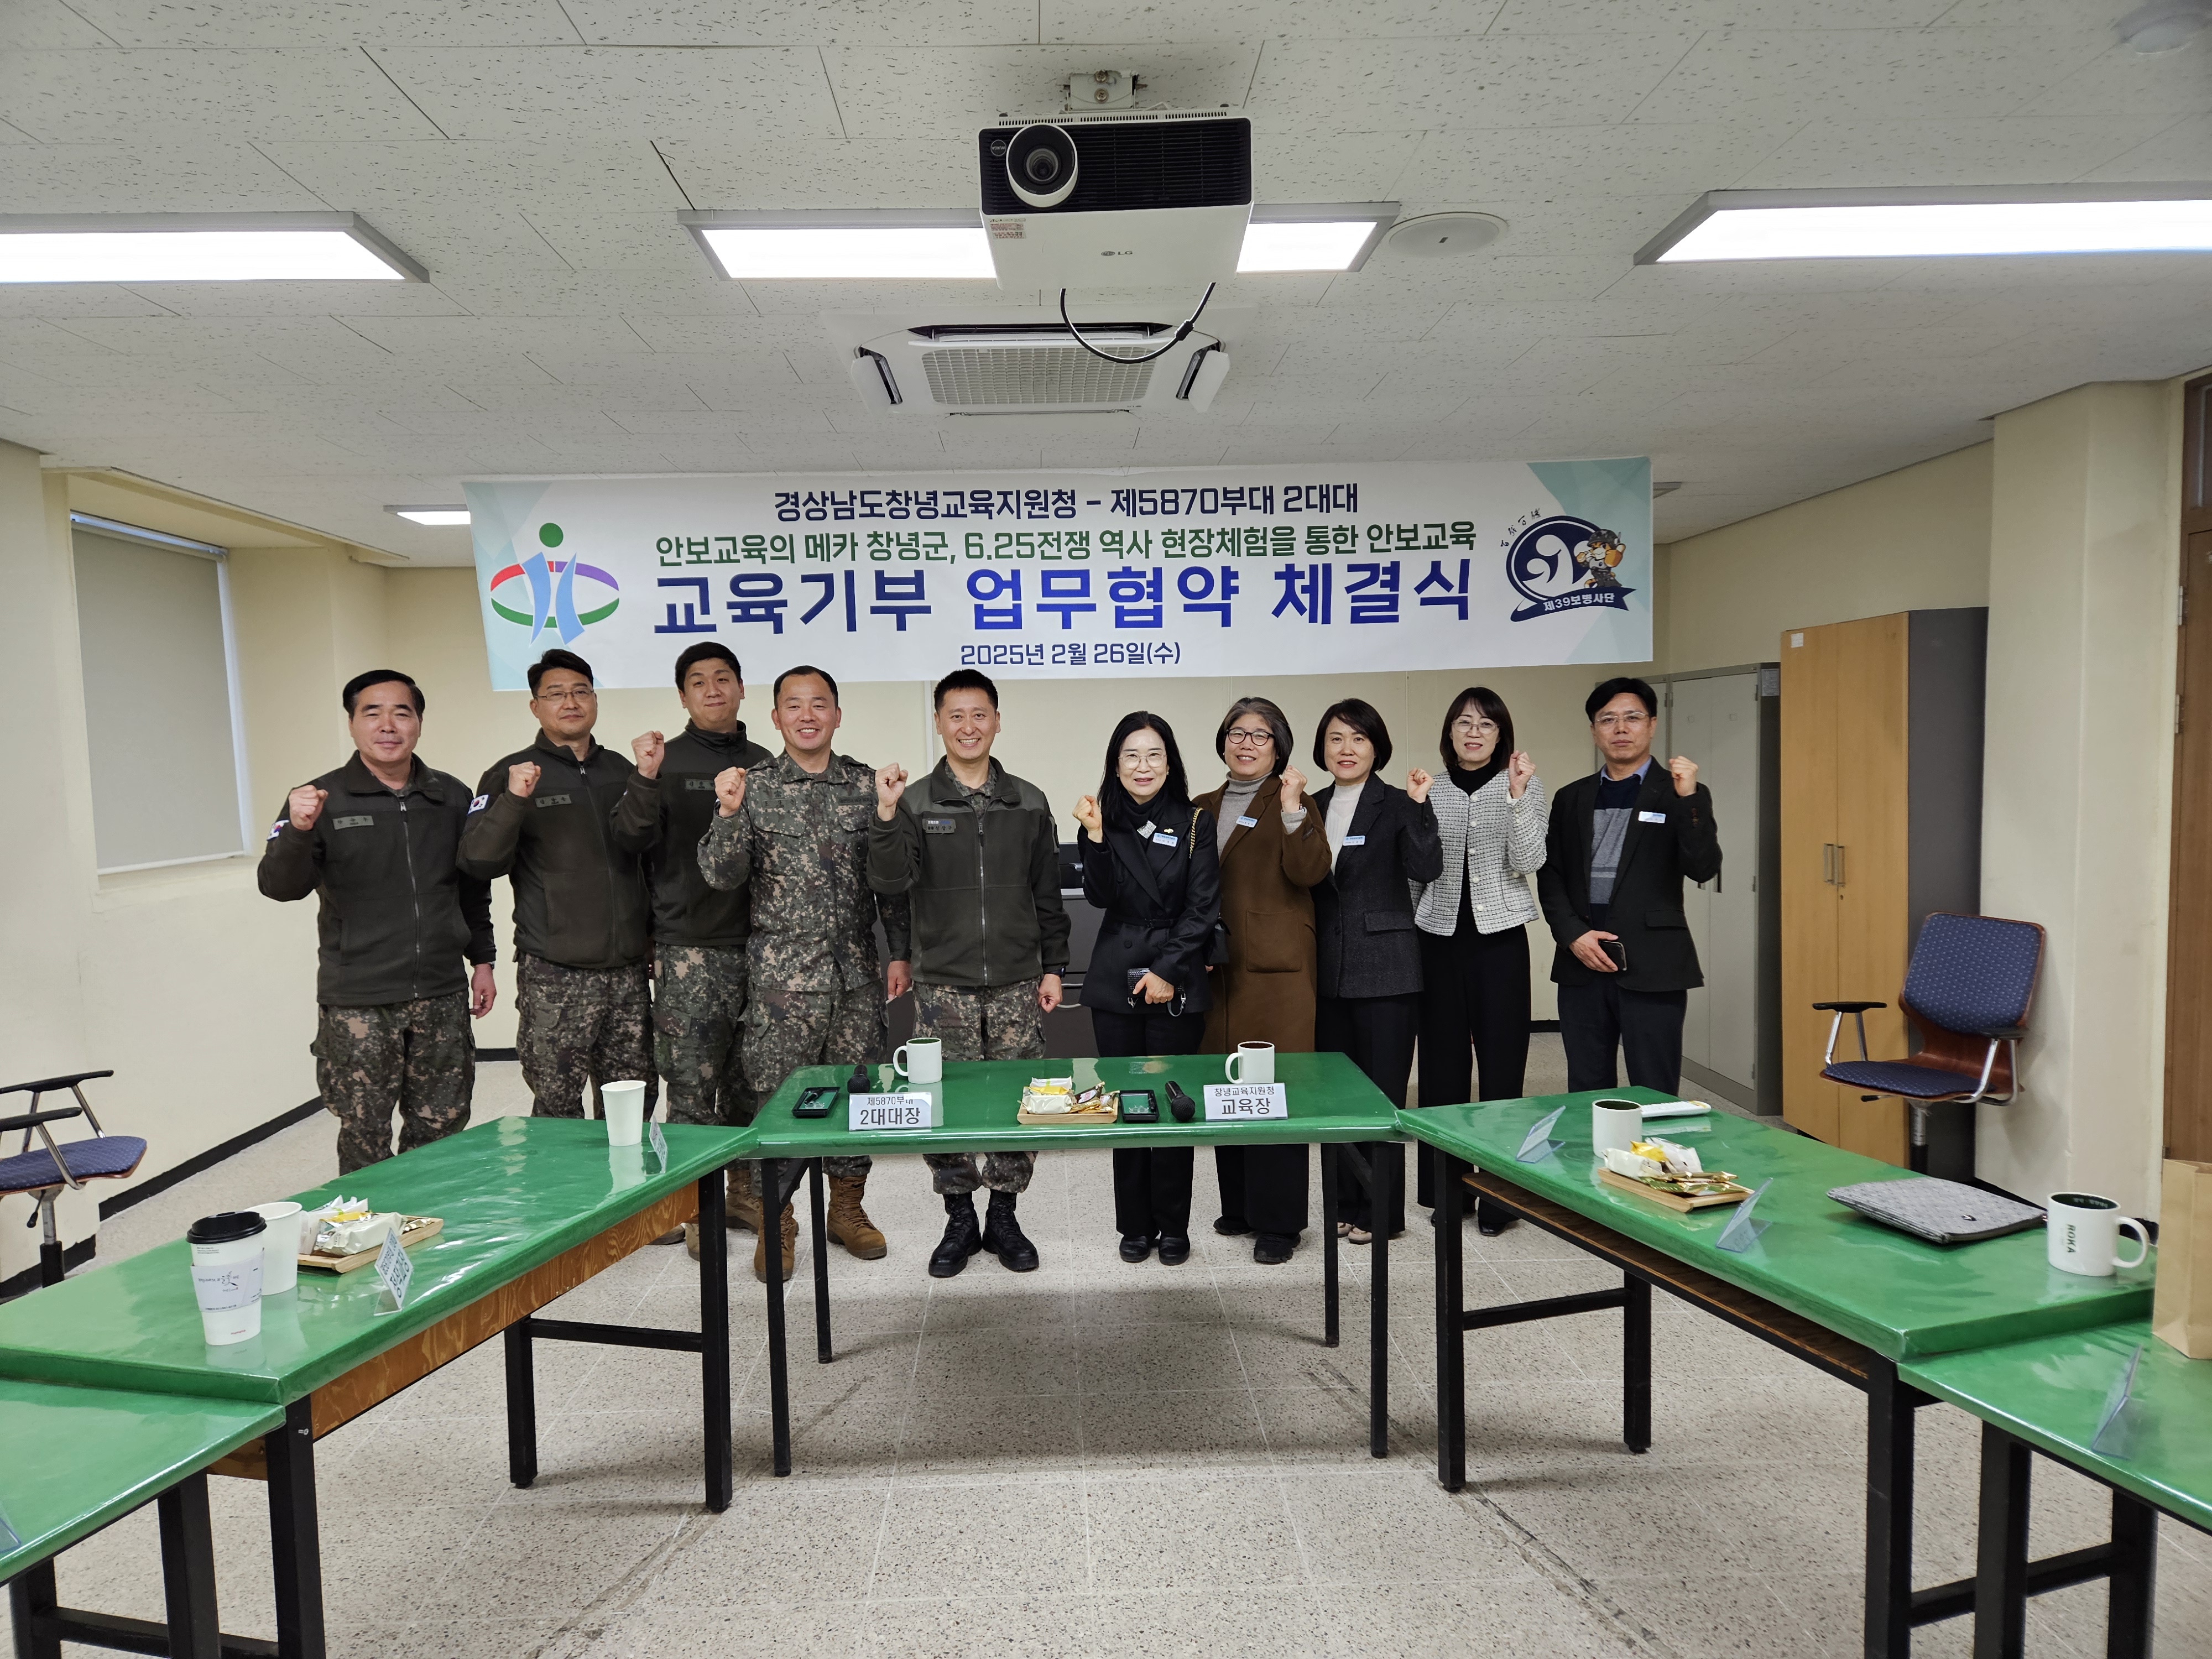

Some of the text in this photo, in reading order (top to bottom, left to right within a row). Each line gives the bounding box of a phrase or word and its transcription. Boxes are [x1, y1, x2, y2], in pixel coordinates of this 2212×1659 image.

[774, 489, 1076, 522] 경상남도창녕교육지원청
[1110, 485, 1274, 518] 제5870부대
[1284, 483, 1358, 514] 2대대
[656, 521, 1477, 567] 안보교육의 메카 창녕군, 6.25전쟁 역사 현장체험을 통한 안보교육
[654, 559, 1470, 634] 교육기부 업무협약 체결식
[1543, 593, 1615, 611] 제39보병사단
[961, 642, 1180, 666] 2025년 2월 26일(수)
[867, 1096, 913, 1105] 제5870부대
[1214, 1086, 1274, 1097] 창녕교육지원청
[860, 1107, 921, 1125] 2대대장
[1222, 1098, 1271, 1115] 교육장
[2067, 1224, 2076, 1253] ROKA
